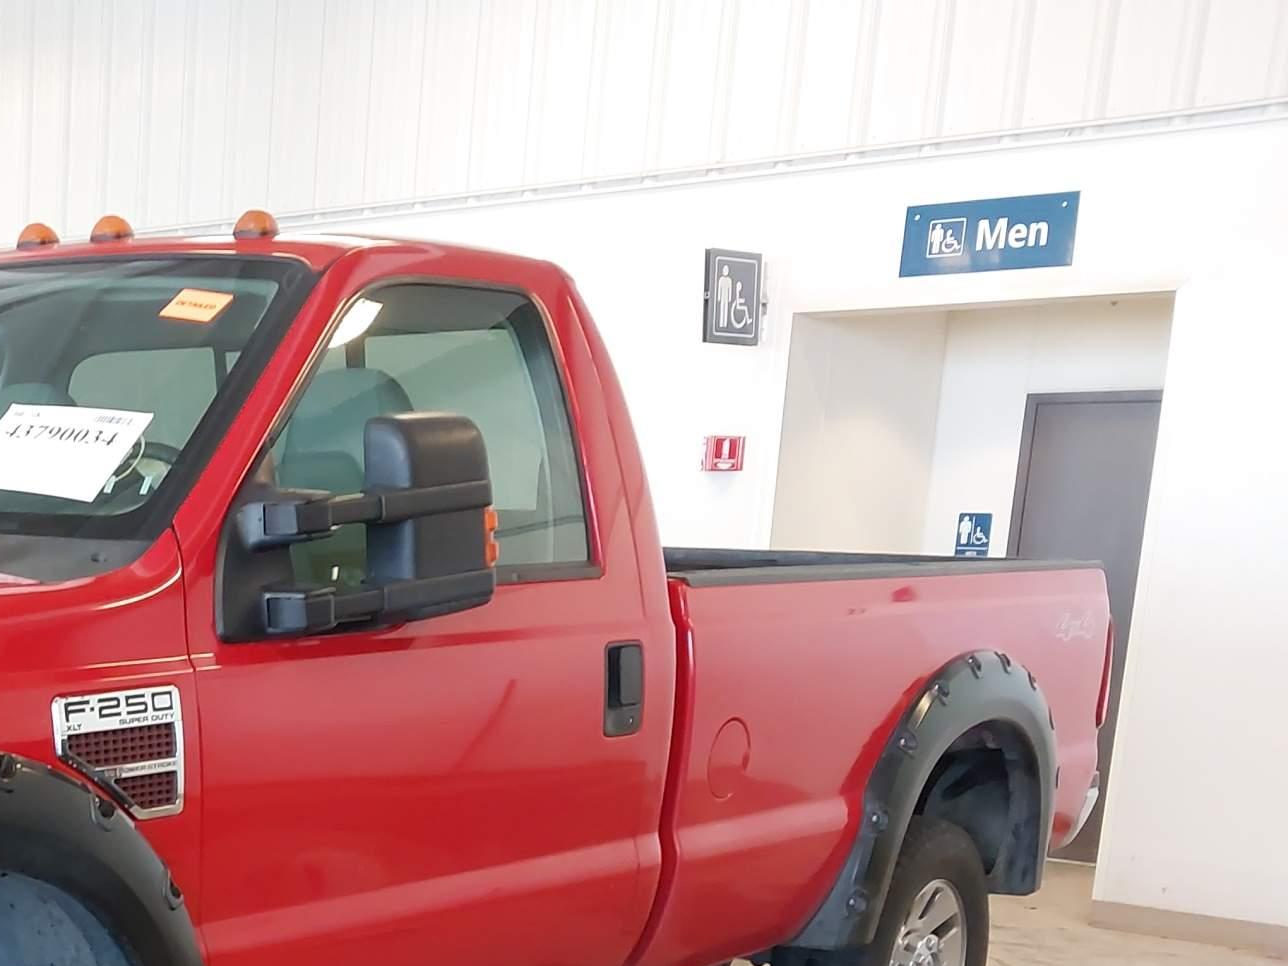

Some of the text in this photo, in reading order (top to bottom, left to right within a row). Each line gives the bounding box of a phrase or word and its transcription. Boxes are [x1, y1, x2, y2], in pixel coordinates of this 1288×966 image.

[975, 217, 1049, 251] Men
[5, 424, 119, 446] 43790034
[119, 713, 174, 725] SUPER DUTY
